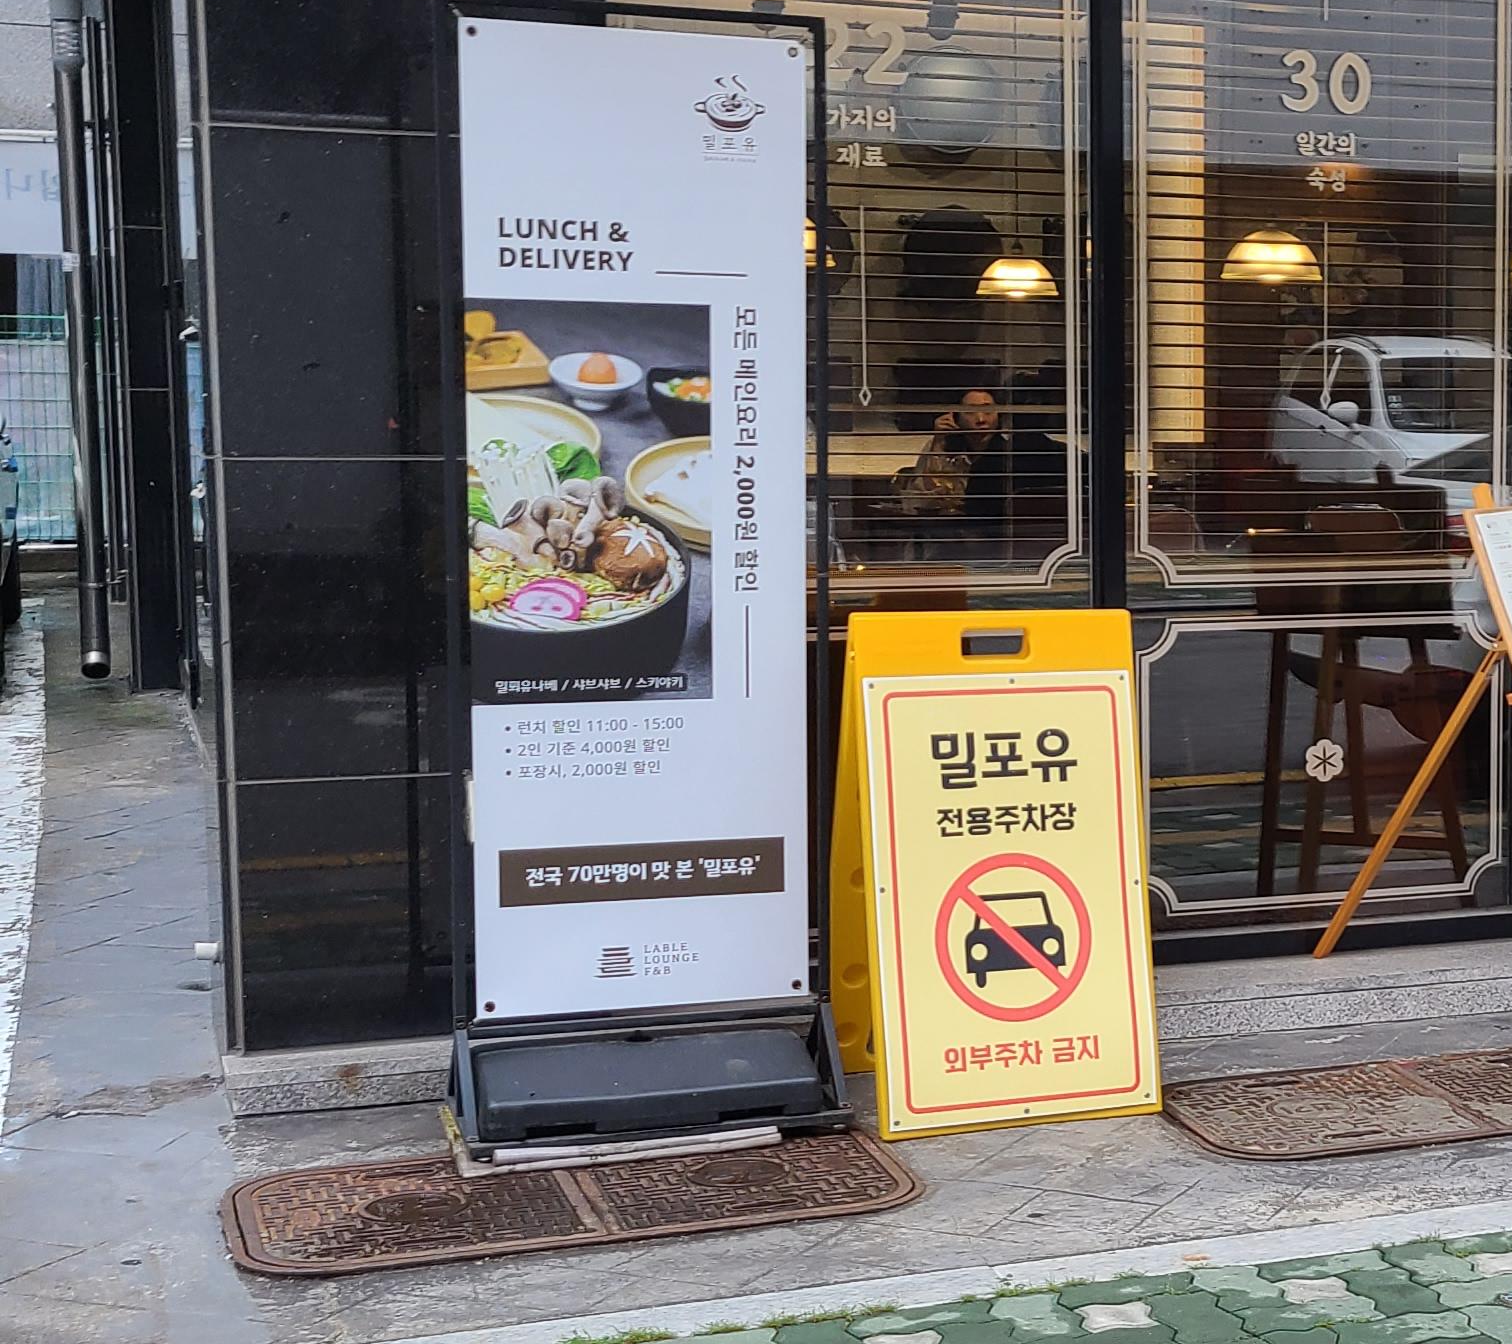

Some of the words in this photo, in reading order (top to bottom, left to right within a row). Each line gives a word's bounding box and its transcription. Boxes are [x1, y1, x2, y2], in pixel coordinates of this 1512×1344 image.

[1280, 49, 1372, 115] 30
[826, 104, 896, 132] 가지의
[703, 135, 758, 152] 밀포유
[836, 142, 888, 168] 재료
[1296, 130, 1356, 156] 일간의
[1305, 167, 1346, 192] 숙성
[498, 217, 598, 241] LUNCH
[609, 222, 629, 242] &
[499, 247, 634, 271] DELIVERY
[733, 307, 757, 350] 모든
[734, 359, 758, 446] 메인요리
[733, 456, 758, 540] 2,000원
[735, 549, 758, 591] 할인
[573, 678, 622, 690] 샤브샤브
[635, 677, 684, 689] 스키야키
[517, 720, 546, 735] 런치
[552, 719, 581, 734] 할인
[588, 719, 628, 732] 11:00
[644, 717, 684, 731] 15:00
[517, 743, 541, 757] 2인
[547, 741, 576, 756] 기준
[580, 739, 636, 756] 4,000원
[643, 738, 670, 753] 할인
[930, 728, 1078, 790] 밀포유
[518, 763, 566, 779] 포장시,
[572, 761, 627, 777] 2,000원
[633, 760, 660, 775] 할인
[936, 802, 1077, 837] 전용주차장
[526, 866, 563, 887] 전국
[568, 862, 647, 884] 70만명이
[651, 861, 671, 881] 맛
[675, 859, 694, 879] 본
[644, 942, 688, 954] LABLE
[644, 953, 700, 965] LOUNGE
[644, 965, 672, 976] F&B
[944, 1039, 1042, 1074] 외부주차
[1052, 1035, 1100, 1062] 금지
